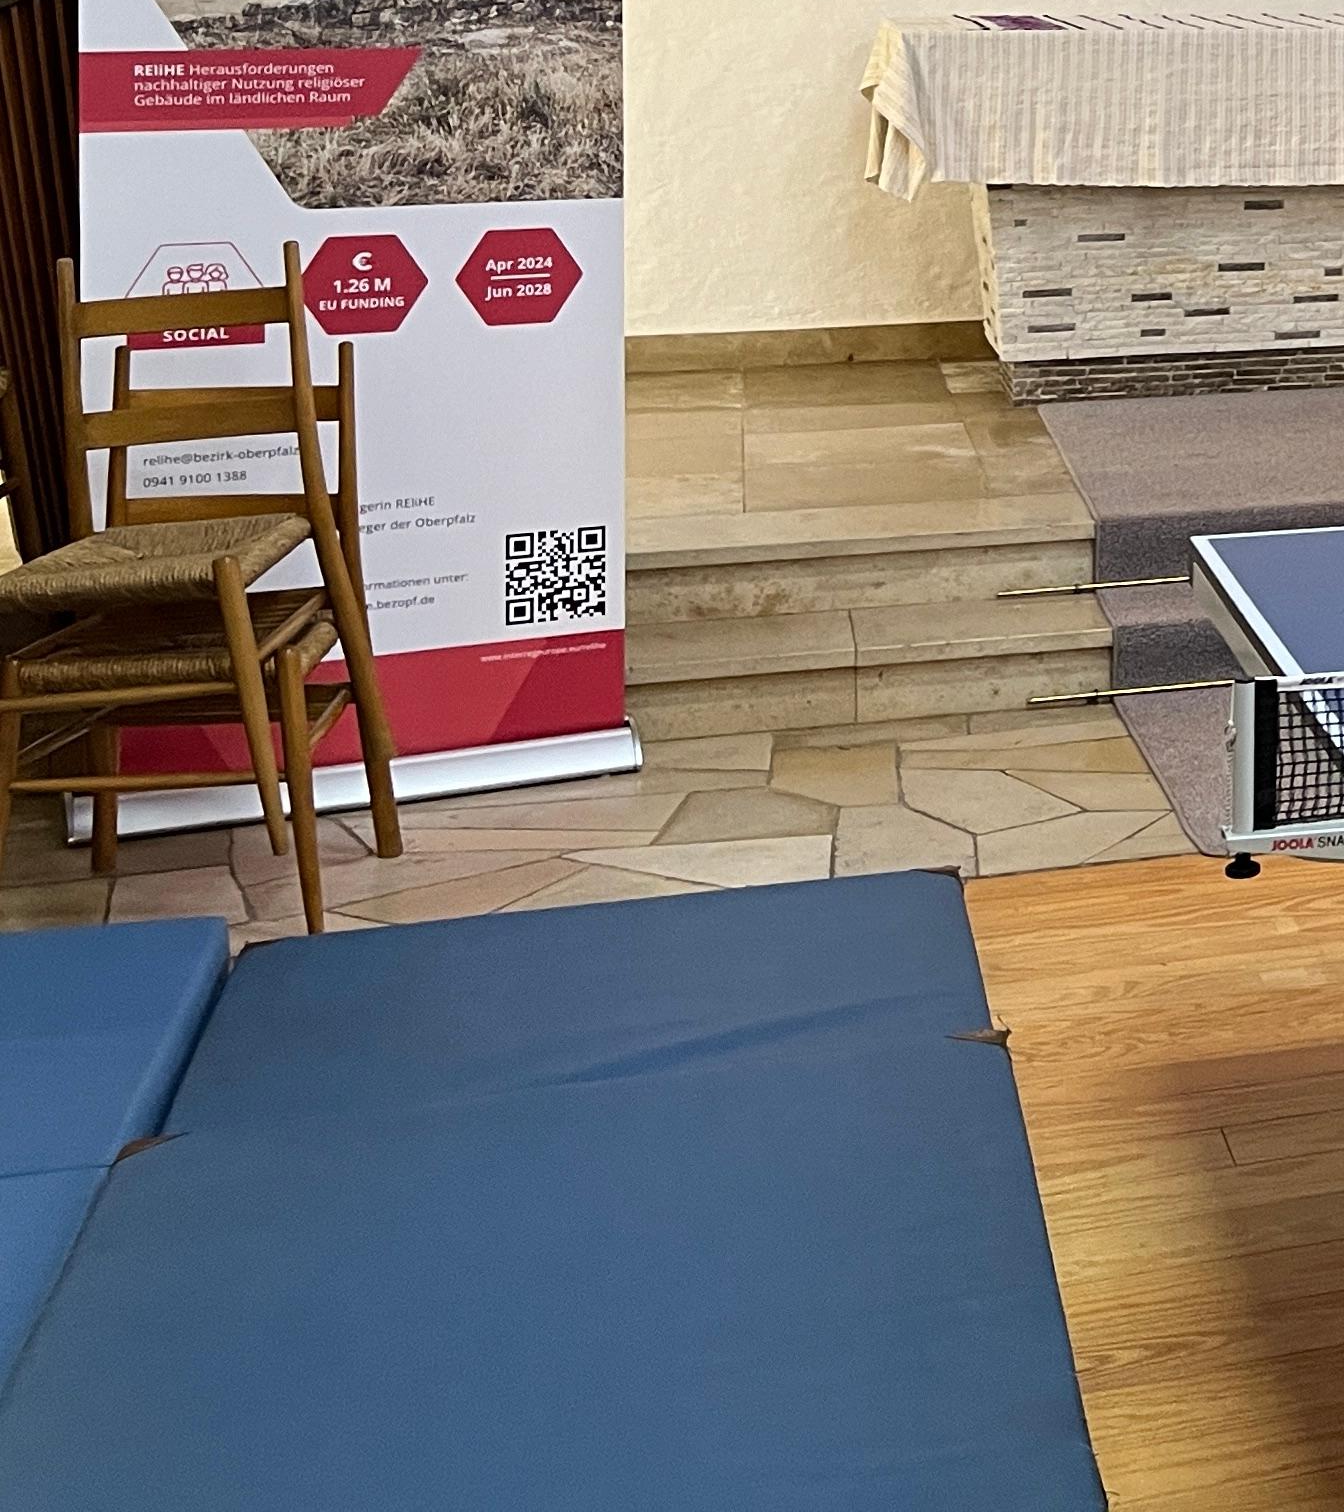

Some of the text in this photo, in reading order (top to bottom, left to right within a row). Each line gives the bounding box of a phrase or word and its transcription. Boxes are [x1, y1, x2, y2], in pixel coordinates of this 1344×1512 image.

[188, 62, 335, 76] Herausforderungen
[134, 75, 366, 94] nachhaltiger Nutzung religiöser
[133, 90, 352, 107] Gebäude im ländlichen Raum
[485, 256, 553, 274] Apr 2024
[333, 277, 392, 294] 1.26 M
[485, 283, 552, 301] Jun 2028
[318, 296, 405, 311] EU FUNDING
[162, 327, 230, 343] SOCIAL
[143, 445, 299, 467] relihe@bezirk-oberpfalz
[143, 470, 247, 488] 0941 9100 1388
[359, 501, 392, 515] gerin
[359, 513, 476, 535] eger der Oberpfalz
[1271, 837, 1315, 851] JOOLA
